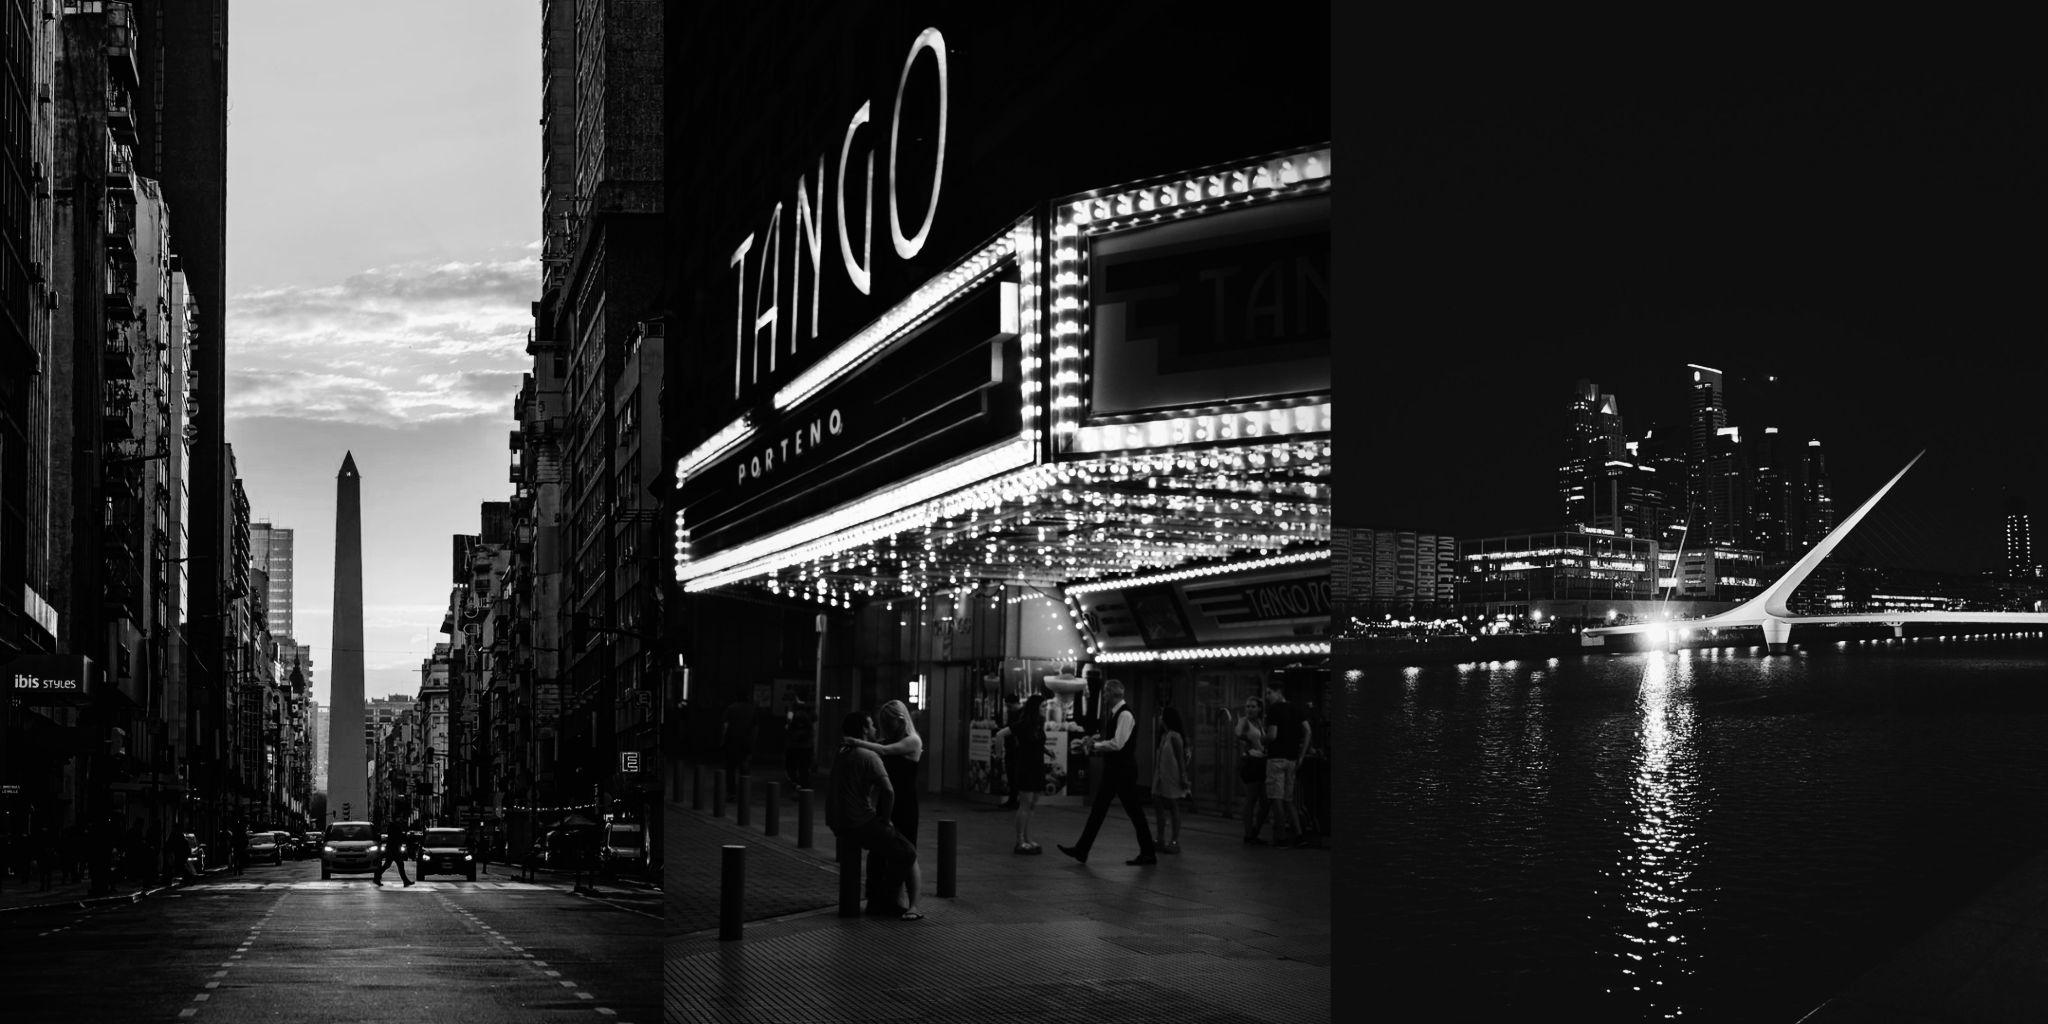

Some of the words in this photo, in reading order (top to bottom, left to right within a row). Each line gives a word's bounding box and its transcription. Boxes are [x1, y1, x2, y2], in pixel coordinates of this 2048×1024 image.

[731, 27, 948, 400] TANGO
[738, 409, 842, 486] PORTENO
[1418, 535, 1435, 596] CREENCIA
[1245, 585, 1310, 618] TANGO
[14, 674, 40, 689] ibis
